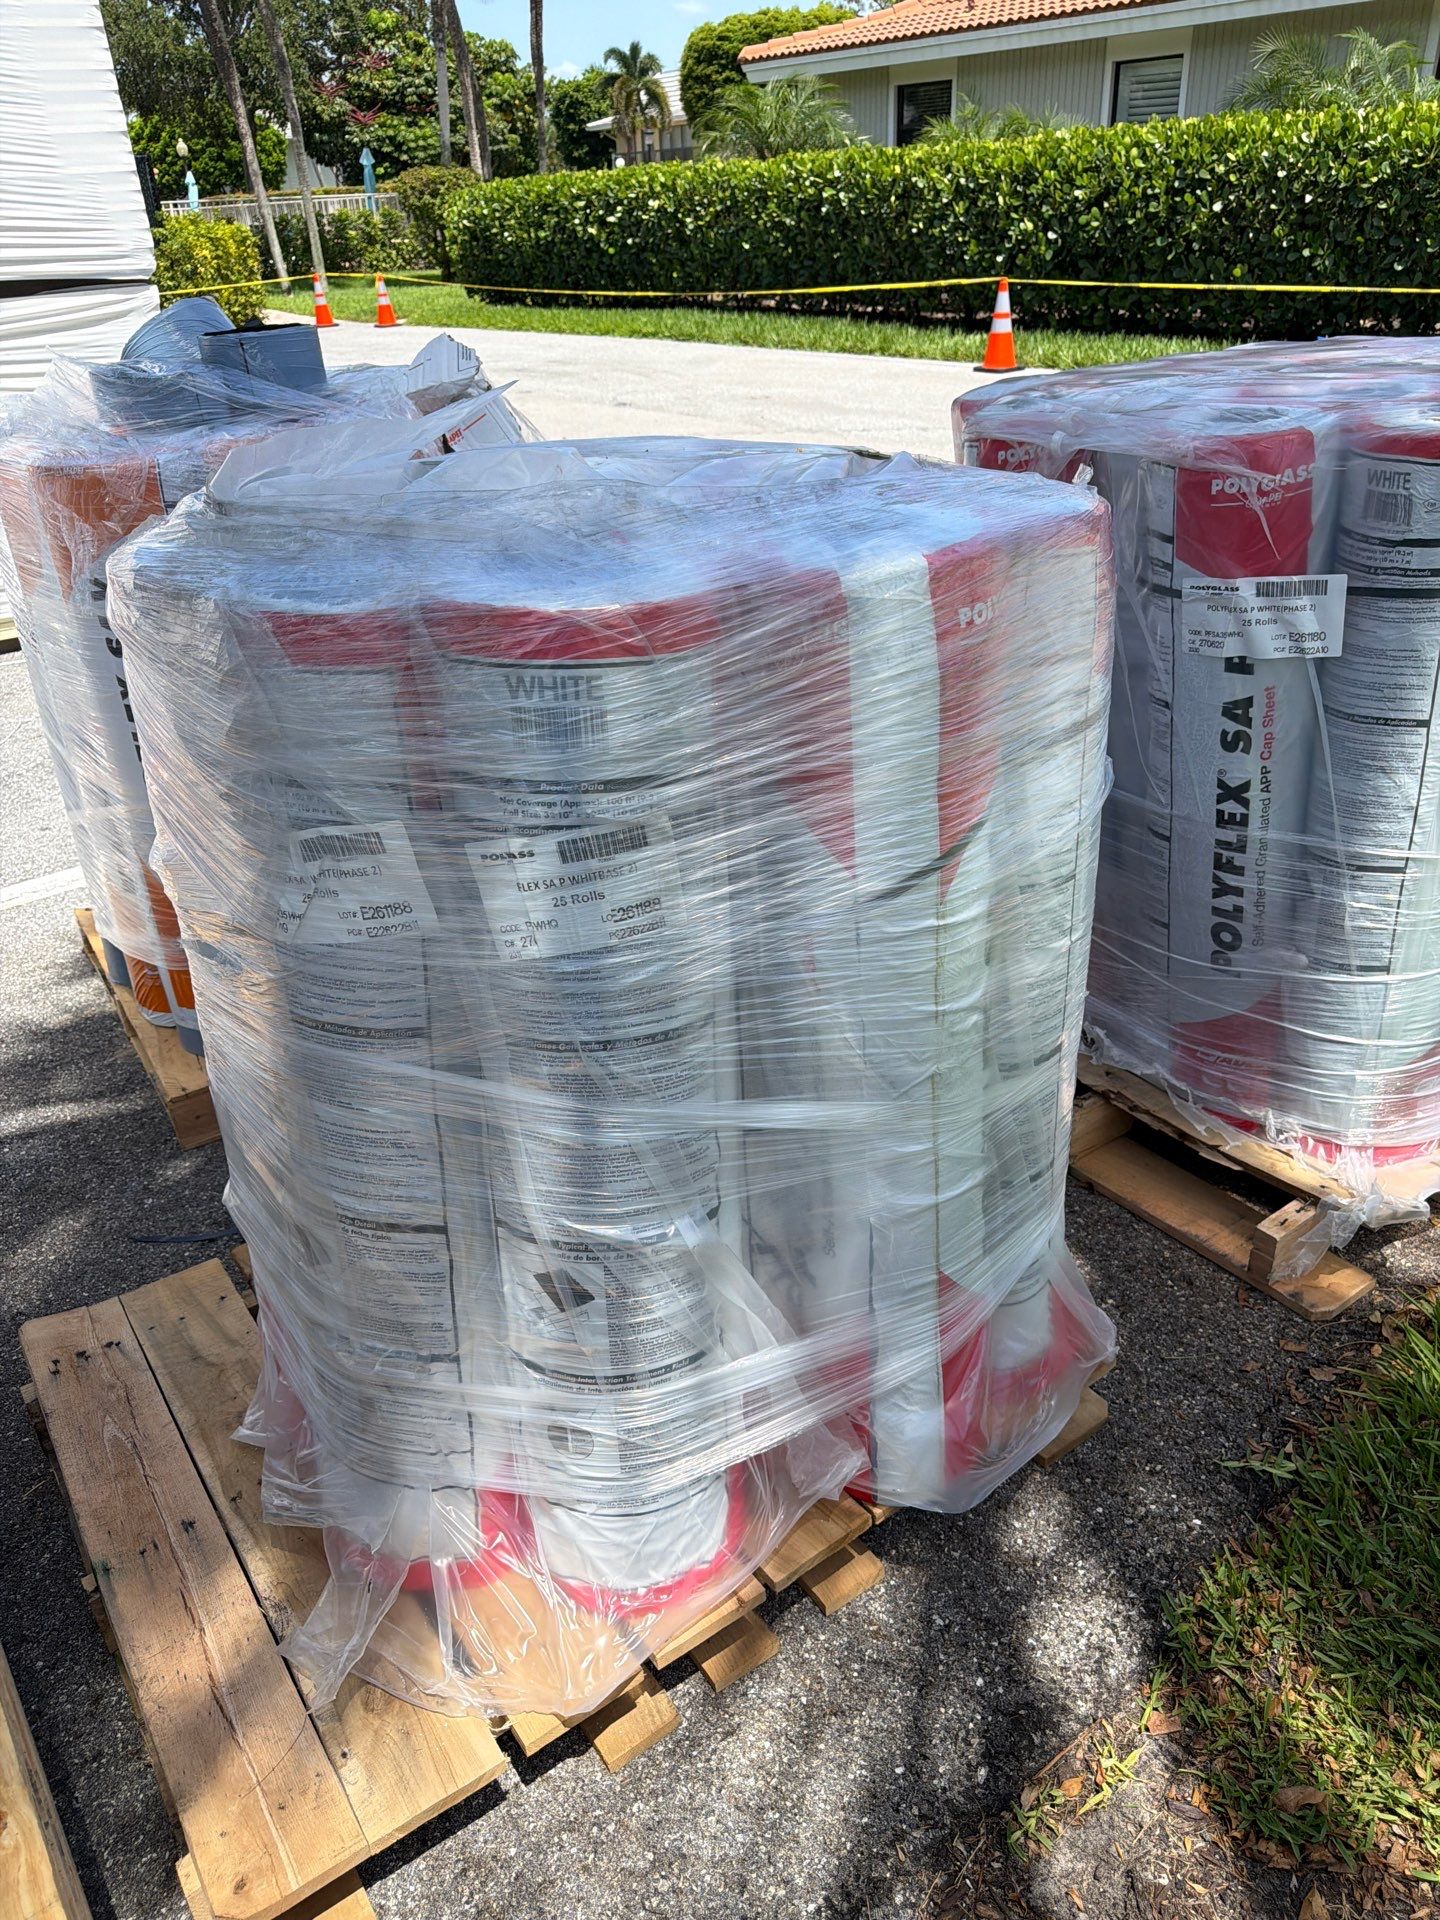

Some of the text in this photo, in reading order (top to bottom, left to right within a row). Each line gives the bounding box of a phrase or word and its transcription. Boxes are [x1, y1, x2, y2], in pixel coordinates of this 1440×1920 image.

[1366, 467, 1412, 491] WHITE
[1238, 606, 1249, 614] SA
[1250, 606, 1256, 614] P
[1257, 603, 1308, 614] WHITE(PHASE
[1308, 603, 1316, 613] 2)
[1242, 617, 1279, 627] 25 Rolls
[1288, 631, 1328, 643] E261180
[1198, 638, 1225, 650] 270620
[1288, 645, 1329, 656] E22622A10
[503, 674, 605, 701] WHITE
[1220, 695, 1255, 756] SA
[580, 782, 605, 791] Data
[515, 798, 558, 808] Coverage
[1252, 685, 1276, 949] Self-Adhered Granulated APP Cap Sheet
[542, 878, 556, 890] SA
[558, 878, 566, 889] P
[312, 887, 340, 899] Rolls
[551, 890, 606, 908] 25 Rolls
[360, 900, 413, 921] E261188
[358, 1028, 368, 1036] de
[369, 1029, 413, 1039] Aplicacón
[671, 1358, 690, 1371] Field
